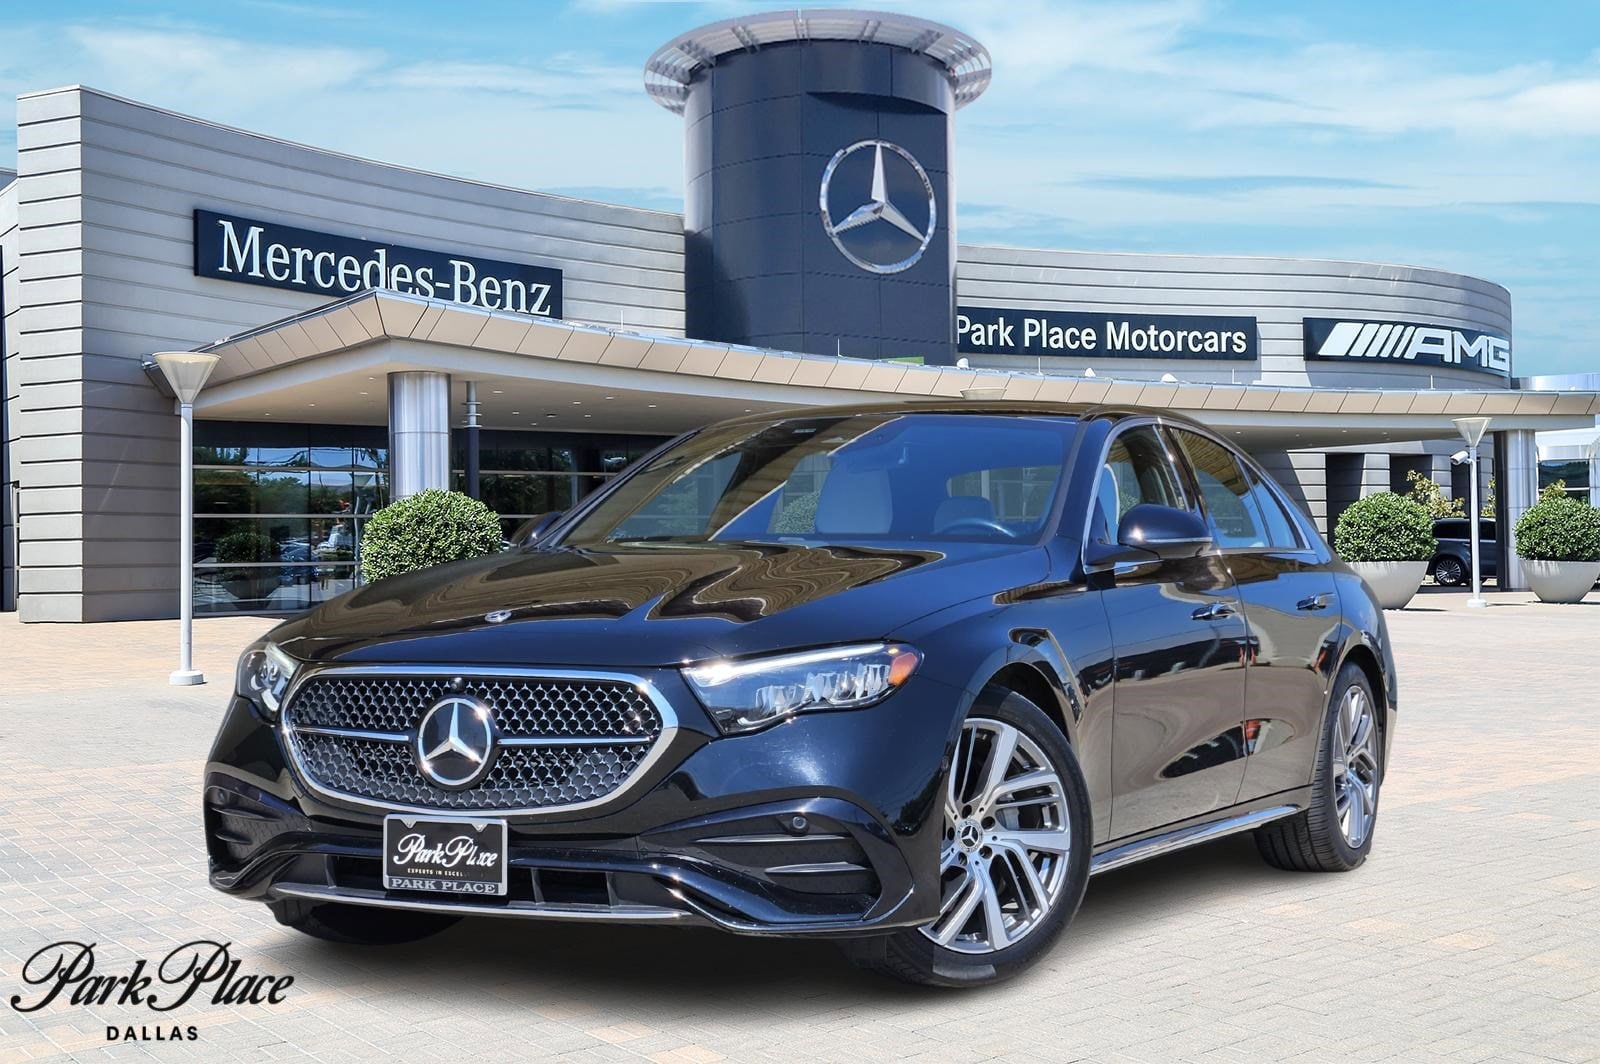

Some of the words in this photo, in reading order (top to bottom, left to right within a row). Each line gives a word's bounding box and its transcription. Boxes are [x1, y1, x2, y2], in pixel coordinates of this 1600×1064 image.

[217, 219, 552, 317] Mercedes-Benz
[957, 315, 1015, 347] Park
[1024, 318, 1097, 350] Place
[1106, 321, 1247, 353] Motorcars
[1403, 326, 1510, 372] AMG
[393, 833, 446, 865] Park
[391, 878, 436, 890] PARK
[441, 881, 496, 894] PLACE
